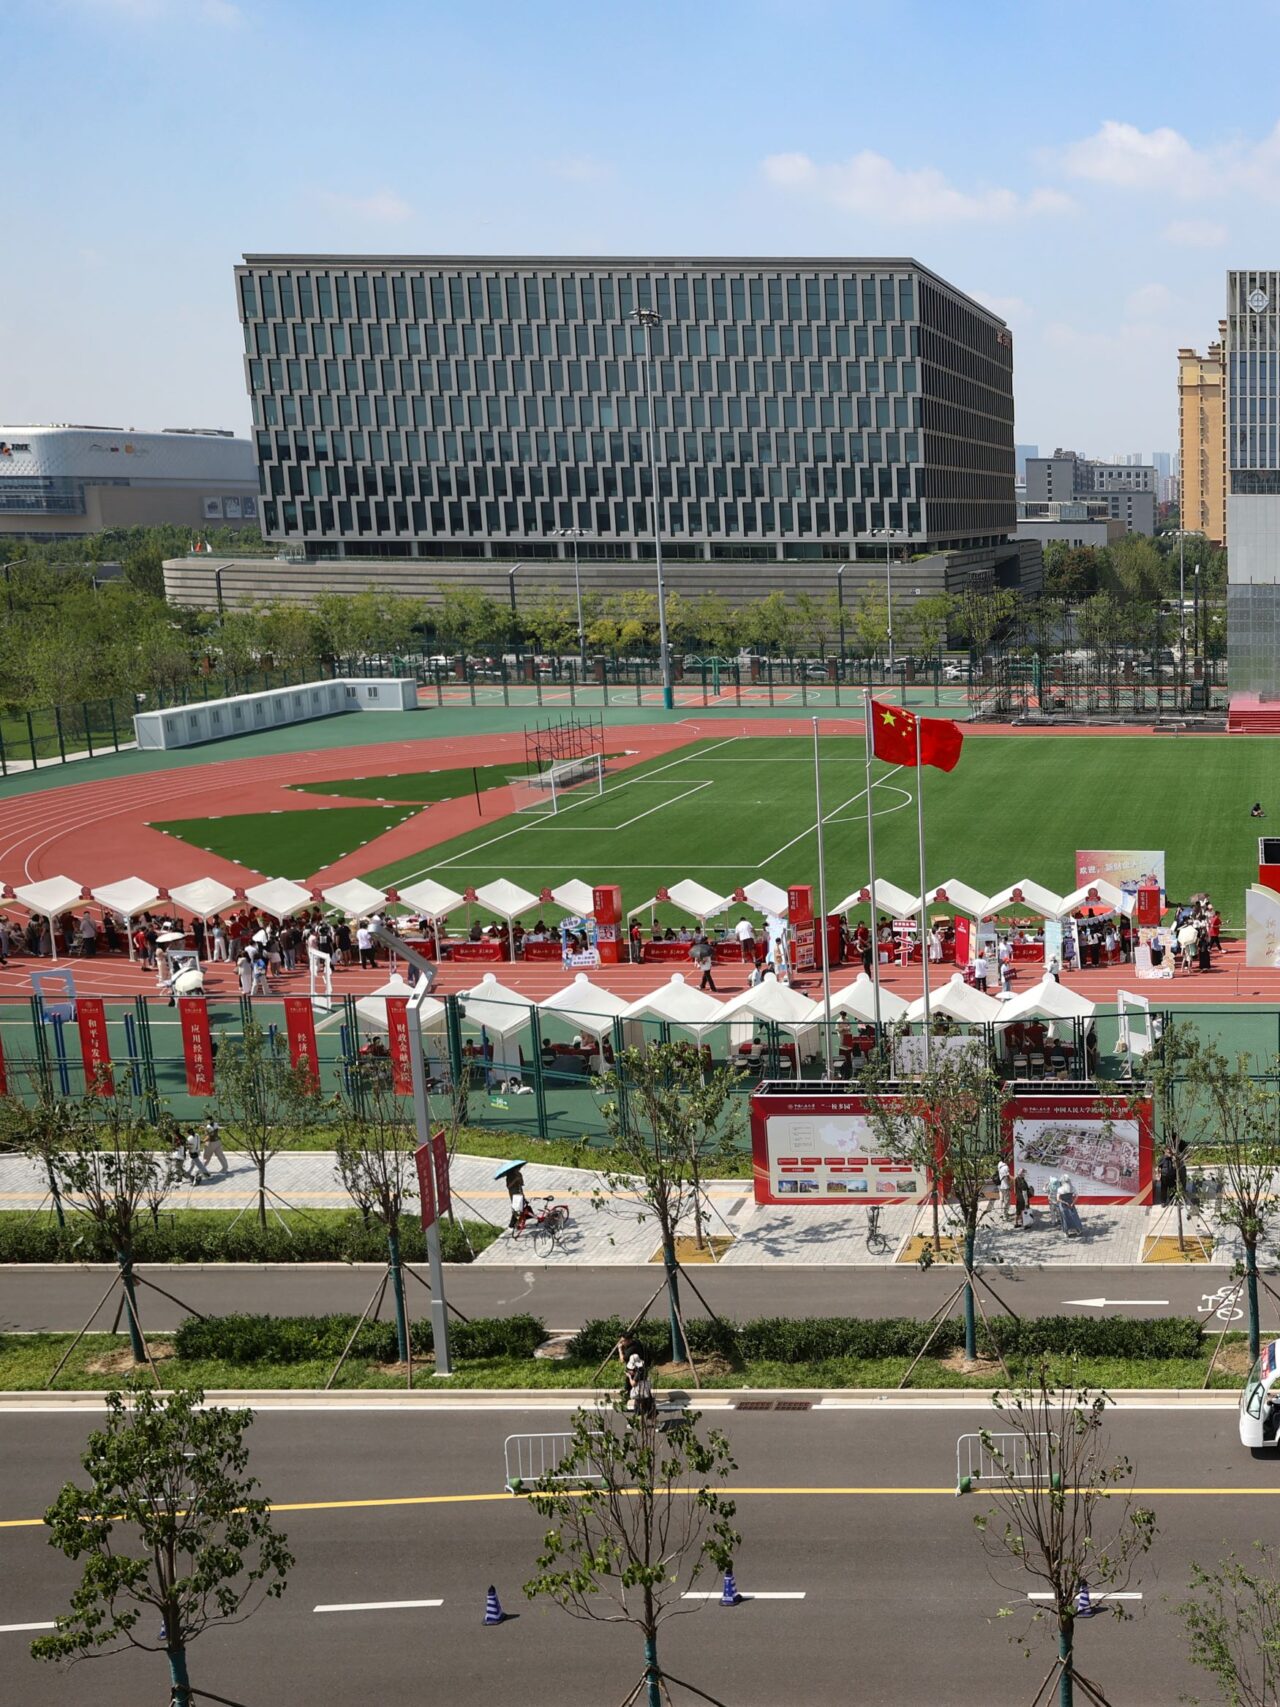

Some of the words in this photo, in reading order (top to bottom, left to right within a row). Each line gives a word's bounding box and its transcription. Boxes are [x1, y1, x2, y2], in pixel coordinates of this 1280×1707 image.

[191, 1024, 206, 1083] 应用经济学院
